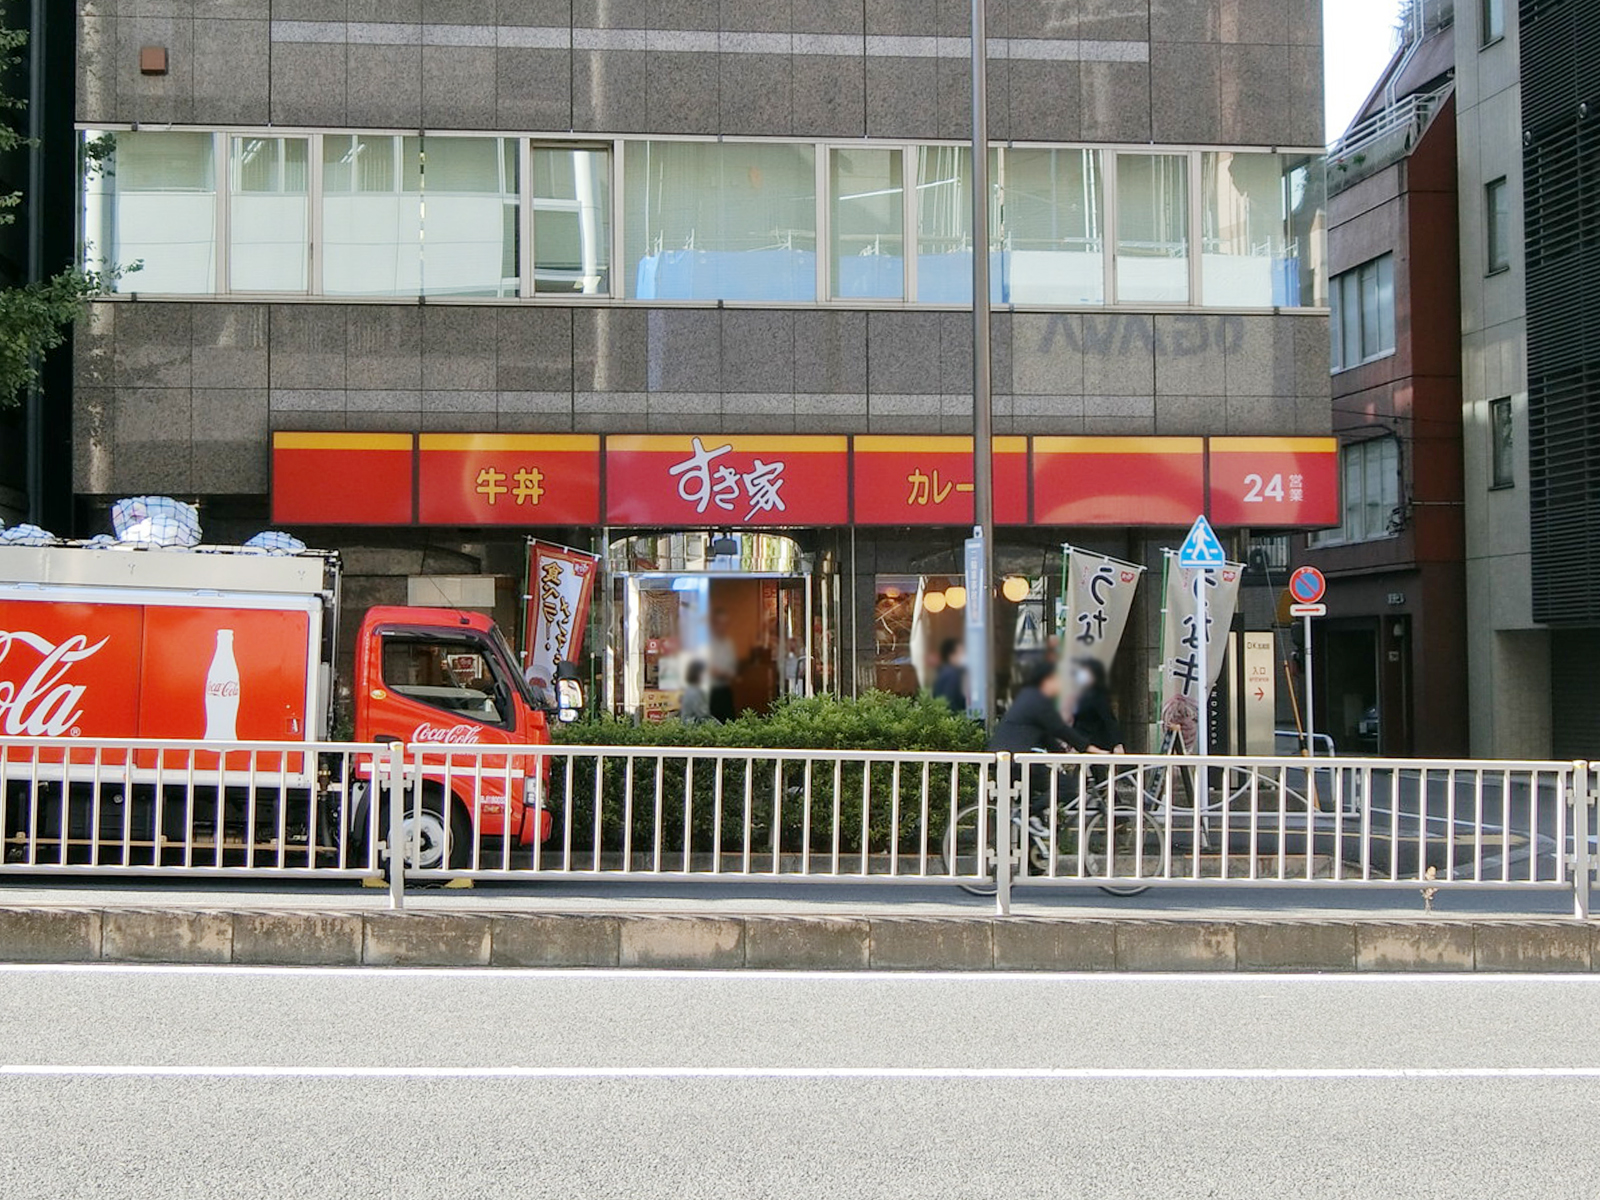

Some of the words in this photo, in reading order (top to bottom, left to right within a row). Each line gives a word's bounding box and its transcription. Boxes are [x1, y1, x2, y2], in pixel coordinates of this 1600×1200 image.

[475, 467, 546, 506] 牛丼
[669, 437, 787, 521] すき家
[907, 468, 974, 506] カレー
[1243, 473, 1285, 503] 24
[1288, 473, 1304, 503] 営業
[1252, 667, 1266, 675] 入口
